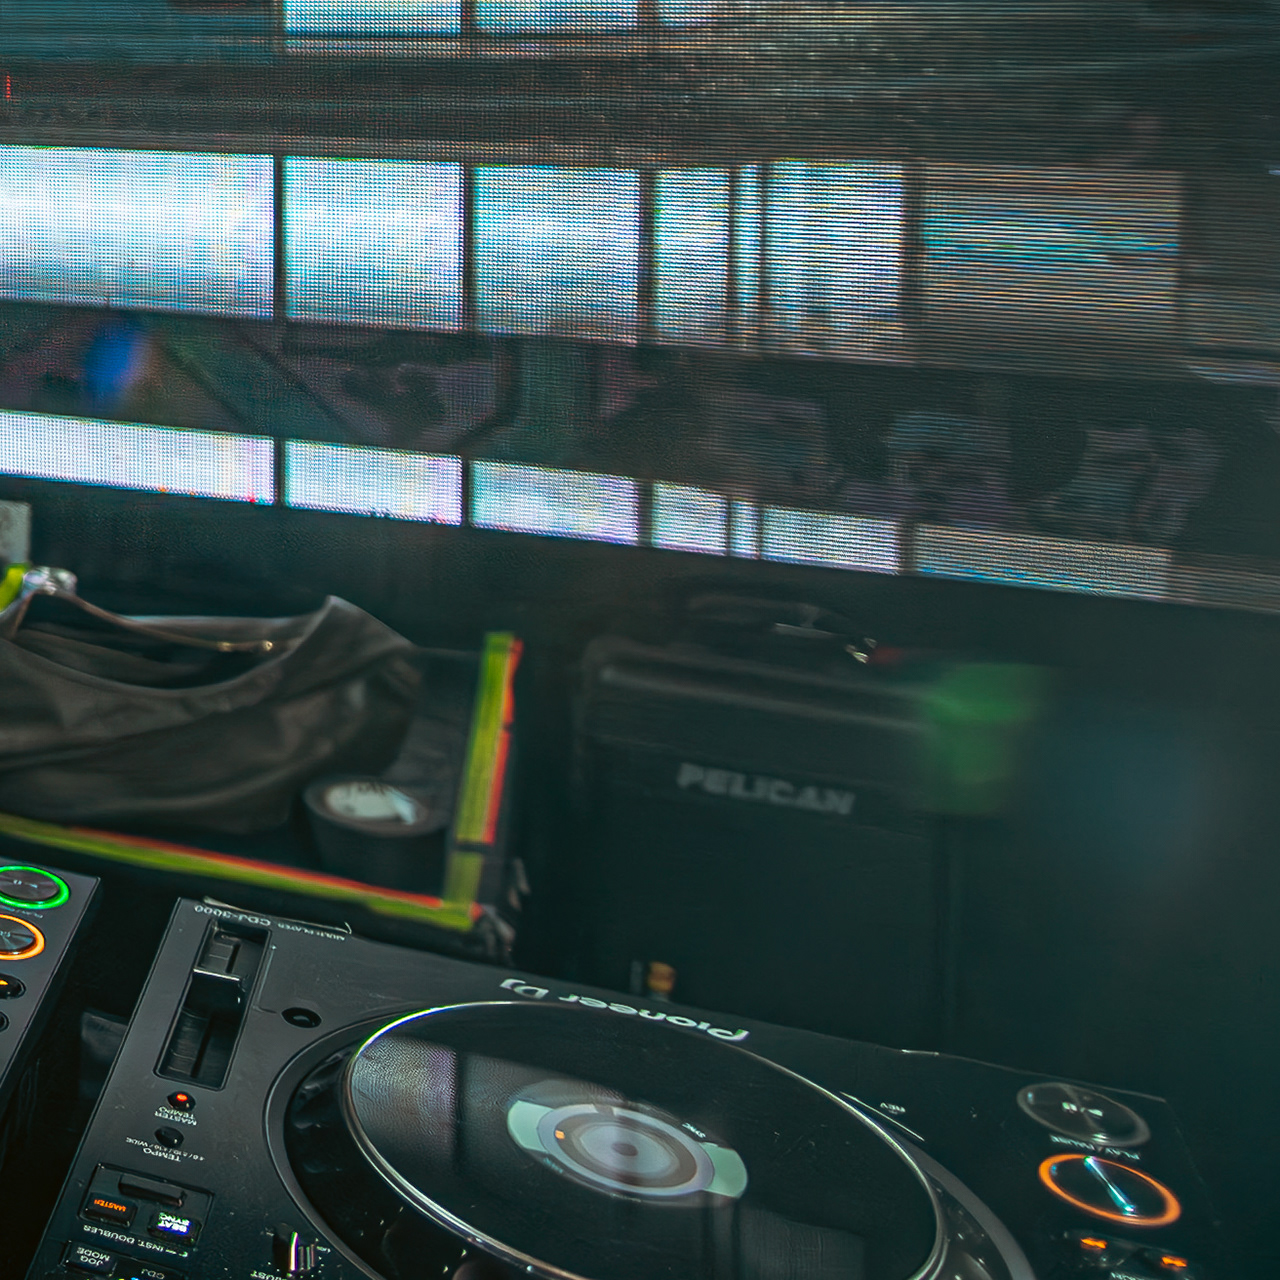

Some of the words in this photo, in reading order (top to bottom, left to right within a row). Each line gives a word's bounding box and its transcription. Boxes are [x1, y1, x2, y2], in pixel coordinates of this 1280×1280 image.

[676, 762, 856, 815] PELICAN
[194, 904, 271, 927] CDJ-3000
[500, 979, 550, 999] DJ
[558, 994, 750, 1041] Pioneer
[154, 1110, 198, 1126] MASTER
[158, 1106, 194, 1120] TEMPO
[142, 1147, 181, 1163] TEMPO
[94, 1199, 127, 1213] MASTER
[159, 1212, 191, 1227] SYNC
[82, 1224, 135, 1245] DOUBLES
[158, 1220, 189, 1236] BEAT
[76, 1246, 111, 1261] MODE
[80, 1255, 103, 1266] JOG
[141, 1269, 165, 1280] CDJ
